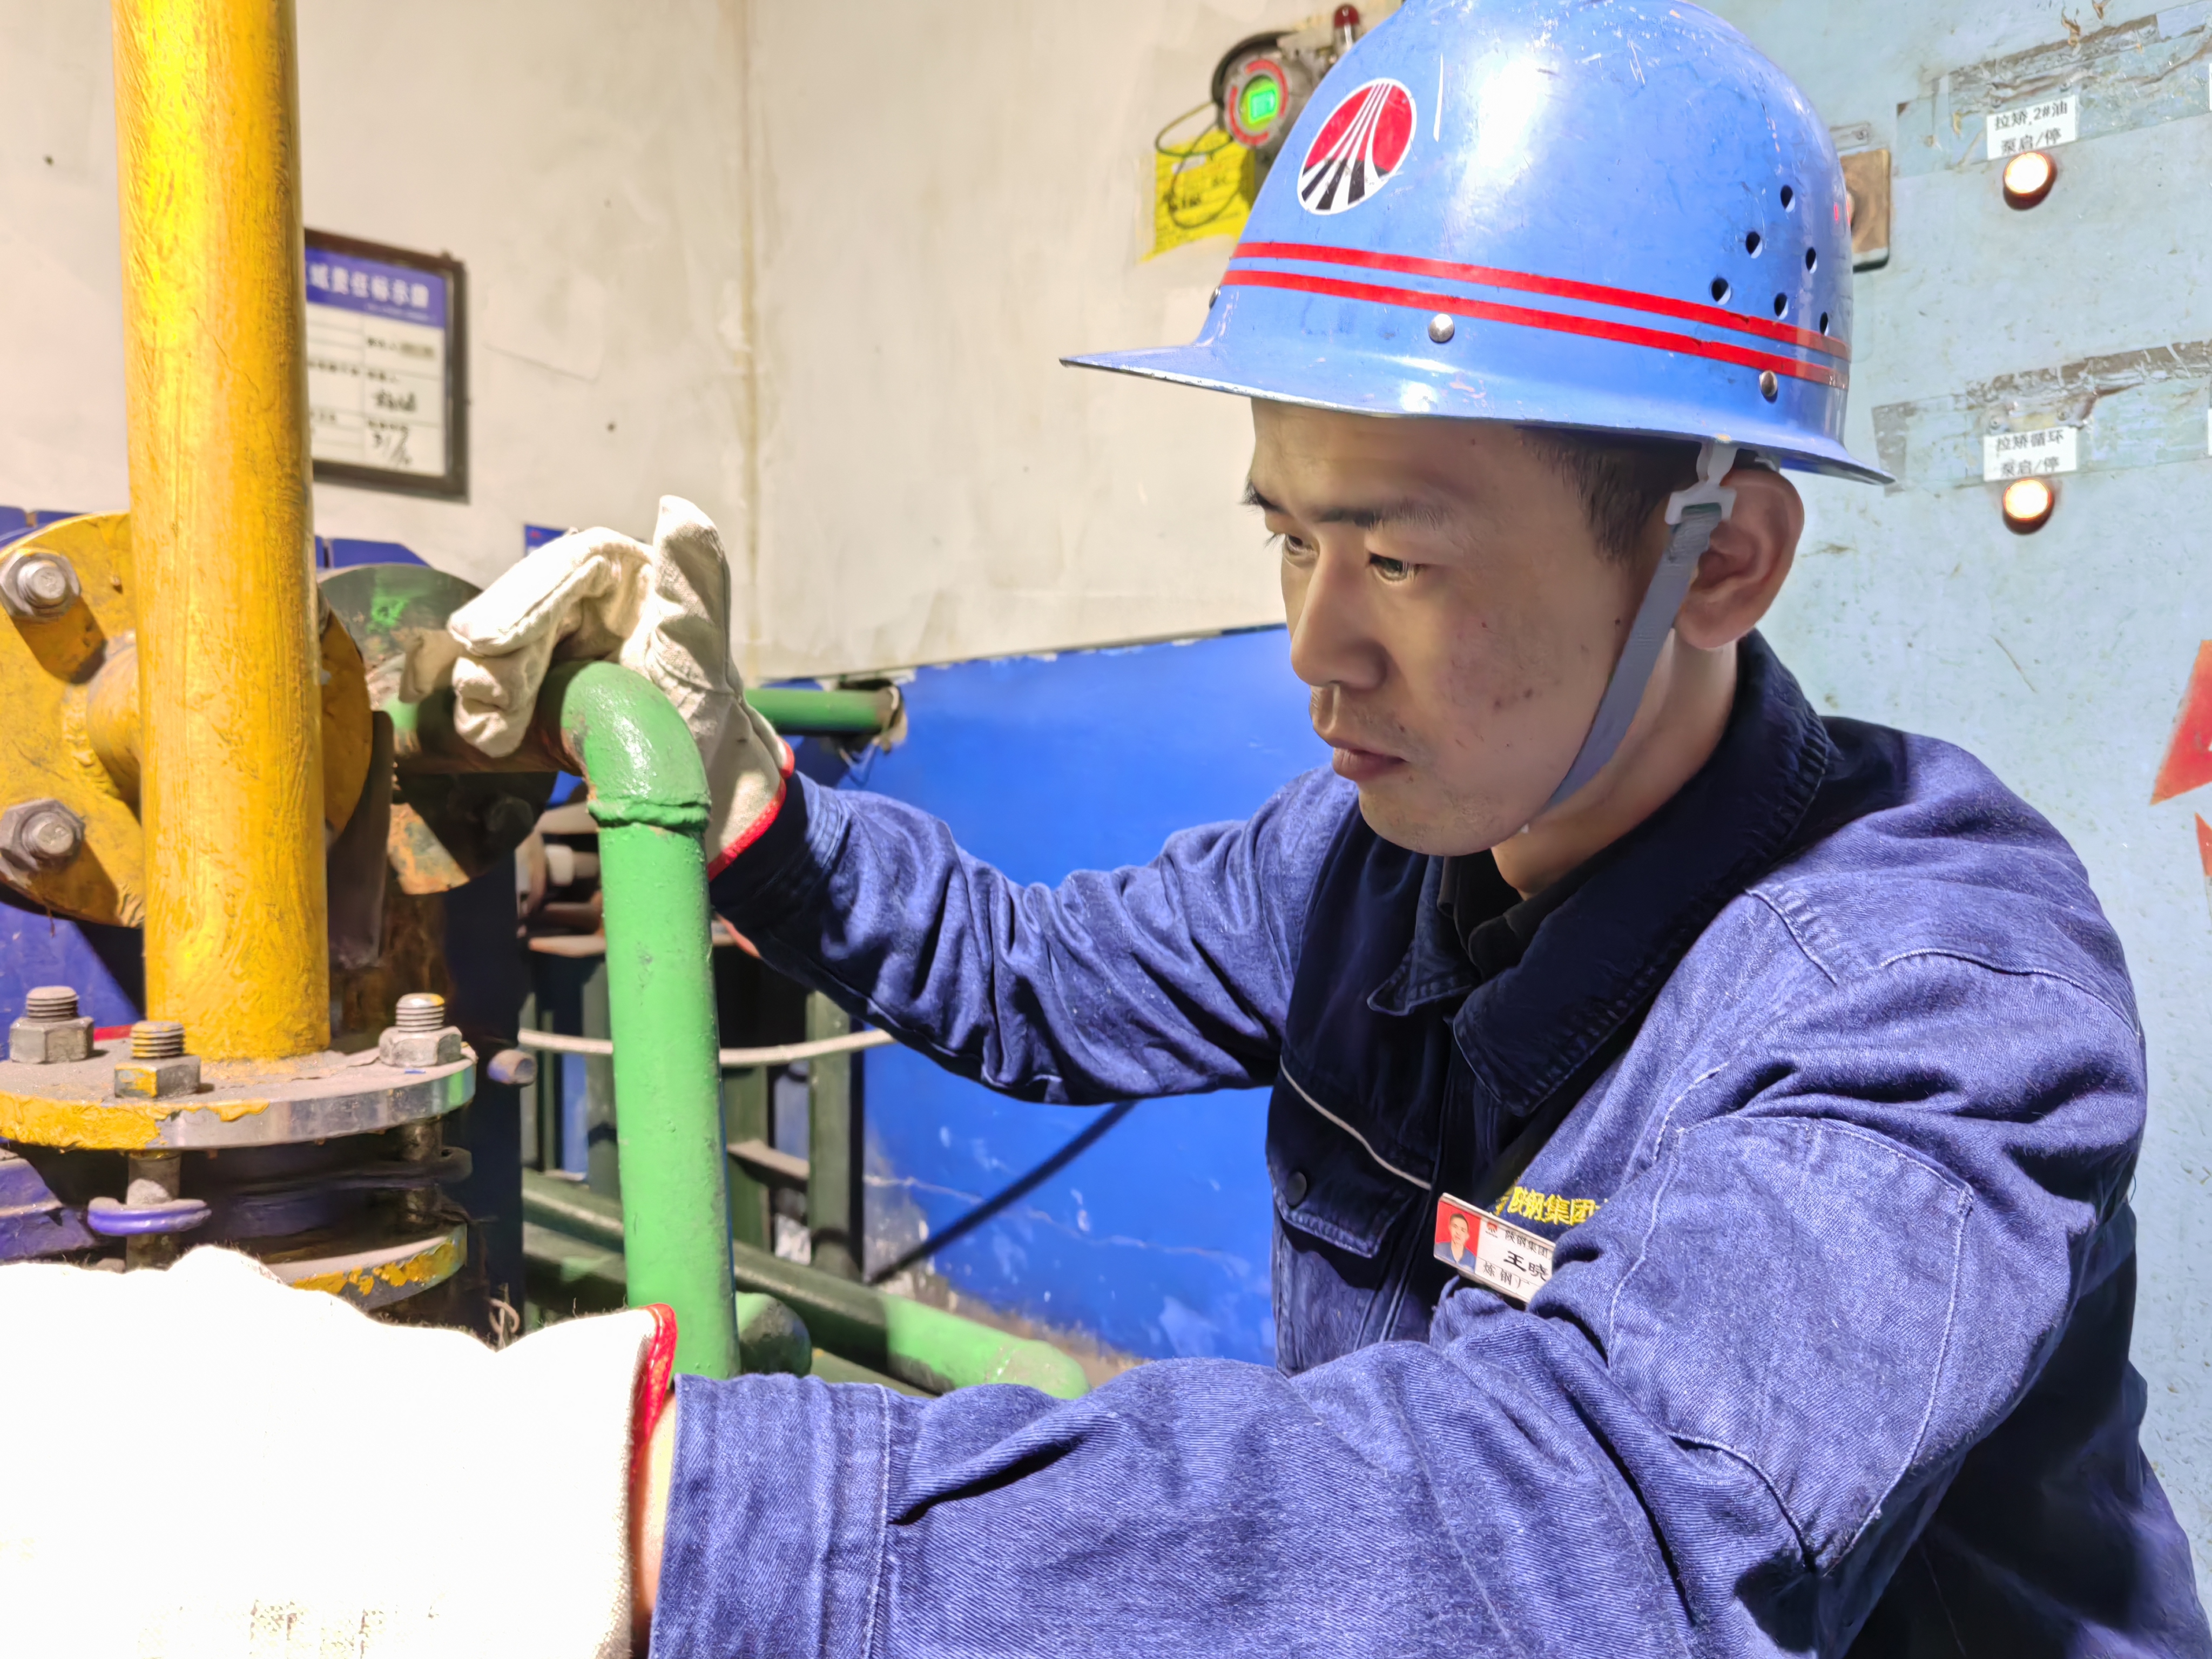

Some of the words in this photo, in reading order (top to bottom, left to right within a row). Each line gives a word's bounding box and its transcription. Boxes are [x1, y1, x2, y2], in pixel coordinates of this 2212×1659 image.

[1505, 1230, 1552, 1260] 陕钢集团
[1482, 1260, 1530, 1289] 炼钢厂
